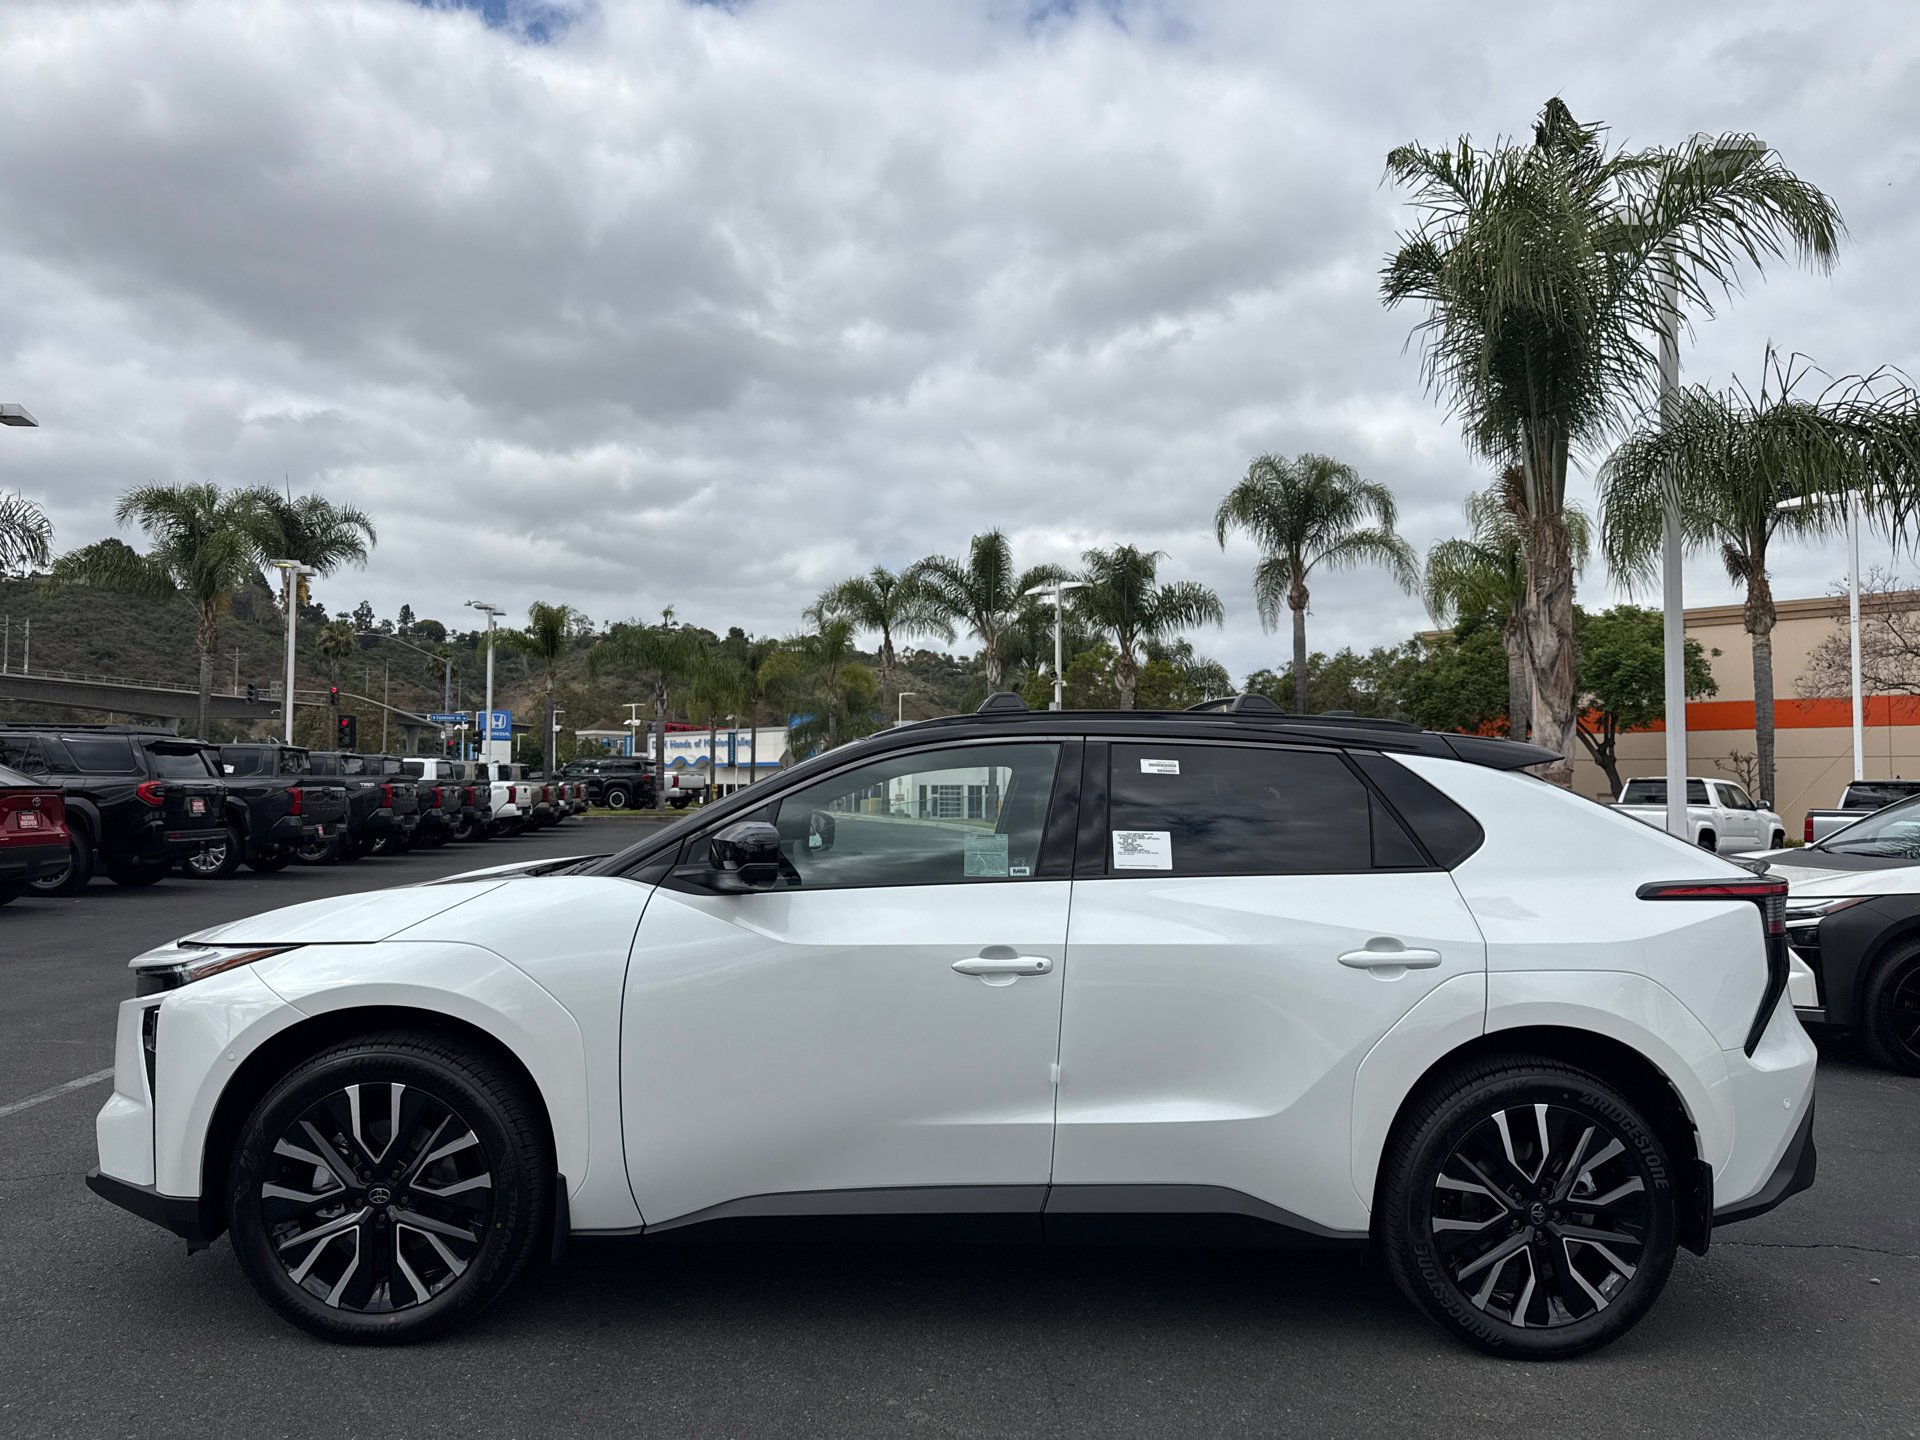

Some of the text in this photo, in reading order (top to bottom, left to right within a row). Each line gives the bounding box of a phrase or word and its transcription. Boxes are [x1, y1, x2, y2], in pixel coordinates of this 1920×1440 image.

[694, 739, 702, 748] of
[1578, 1089, 1671, 1191] BRIDGESTONE
[1412, 1243, 1504, 1347] BRIDGESTONE
